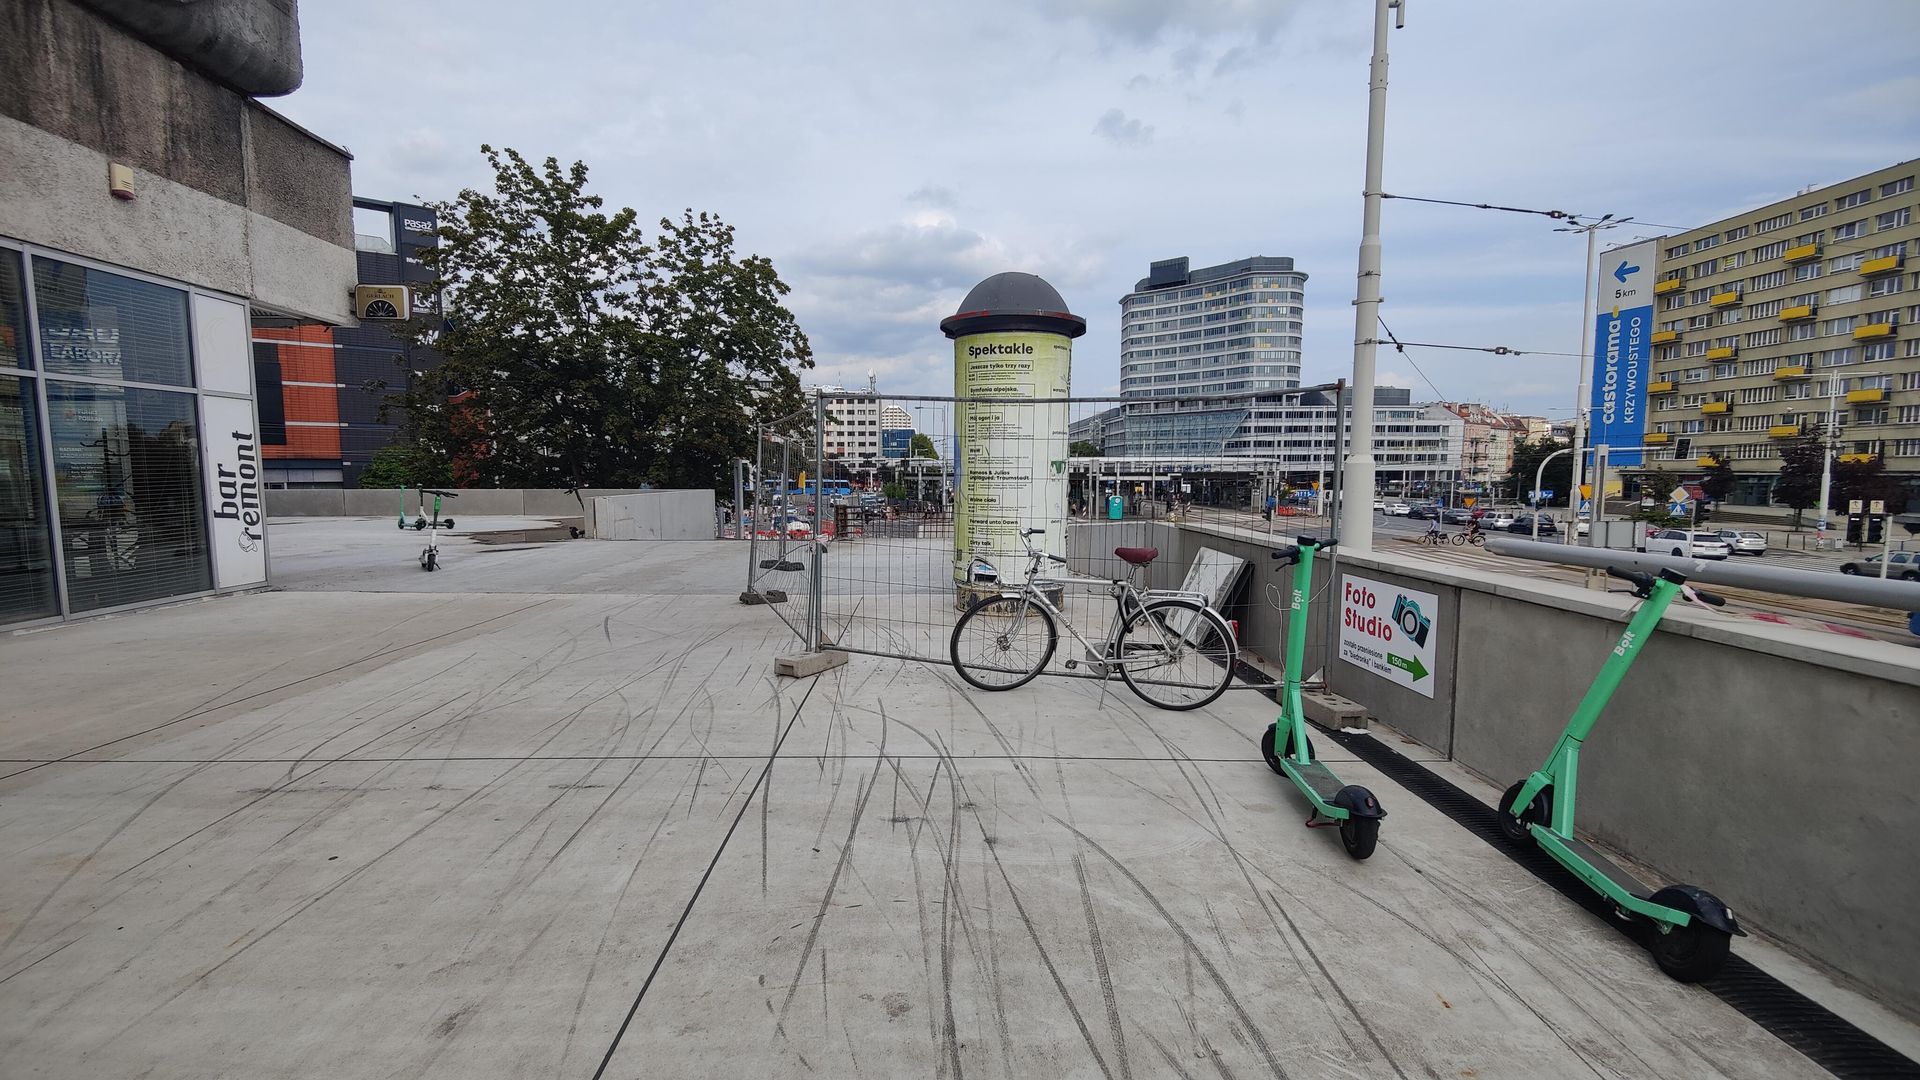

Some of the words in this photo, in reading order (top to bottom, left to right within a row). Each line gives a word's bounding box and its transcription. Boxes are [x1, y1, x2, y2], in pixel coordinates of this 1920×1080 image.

[1615, 288, 1622, 299] 5
[1622, 288, 1636, 297] km
[968, 343, 1034, 359] Spektakle
[989, 362, 1004, 370] tylko
[1005, 361, 1017, 370] trzy
[1018, 362, 1031, 370] razy
[1602, 319, 1621, 425] castorama
[1623, 316, 1641, 424] KRZYWOUSTEGO
[214, 463, 240, 521] bar
[231, 430, 262, 541] remont
[1291, 589, 1302, 610] Bolt
[1345, 582, 1376, 609] Foto
[1344, 607, 1393, 642] Studio
[1613, 630, 1636, 657] Bolt
[1391, 656, 1402, 667] 150
